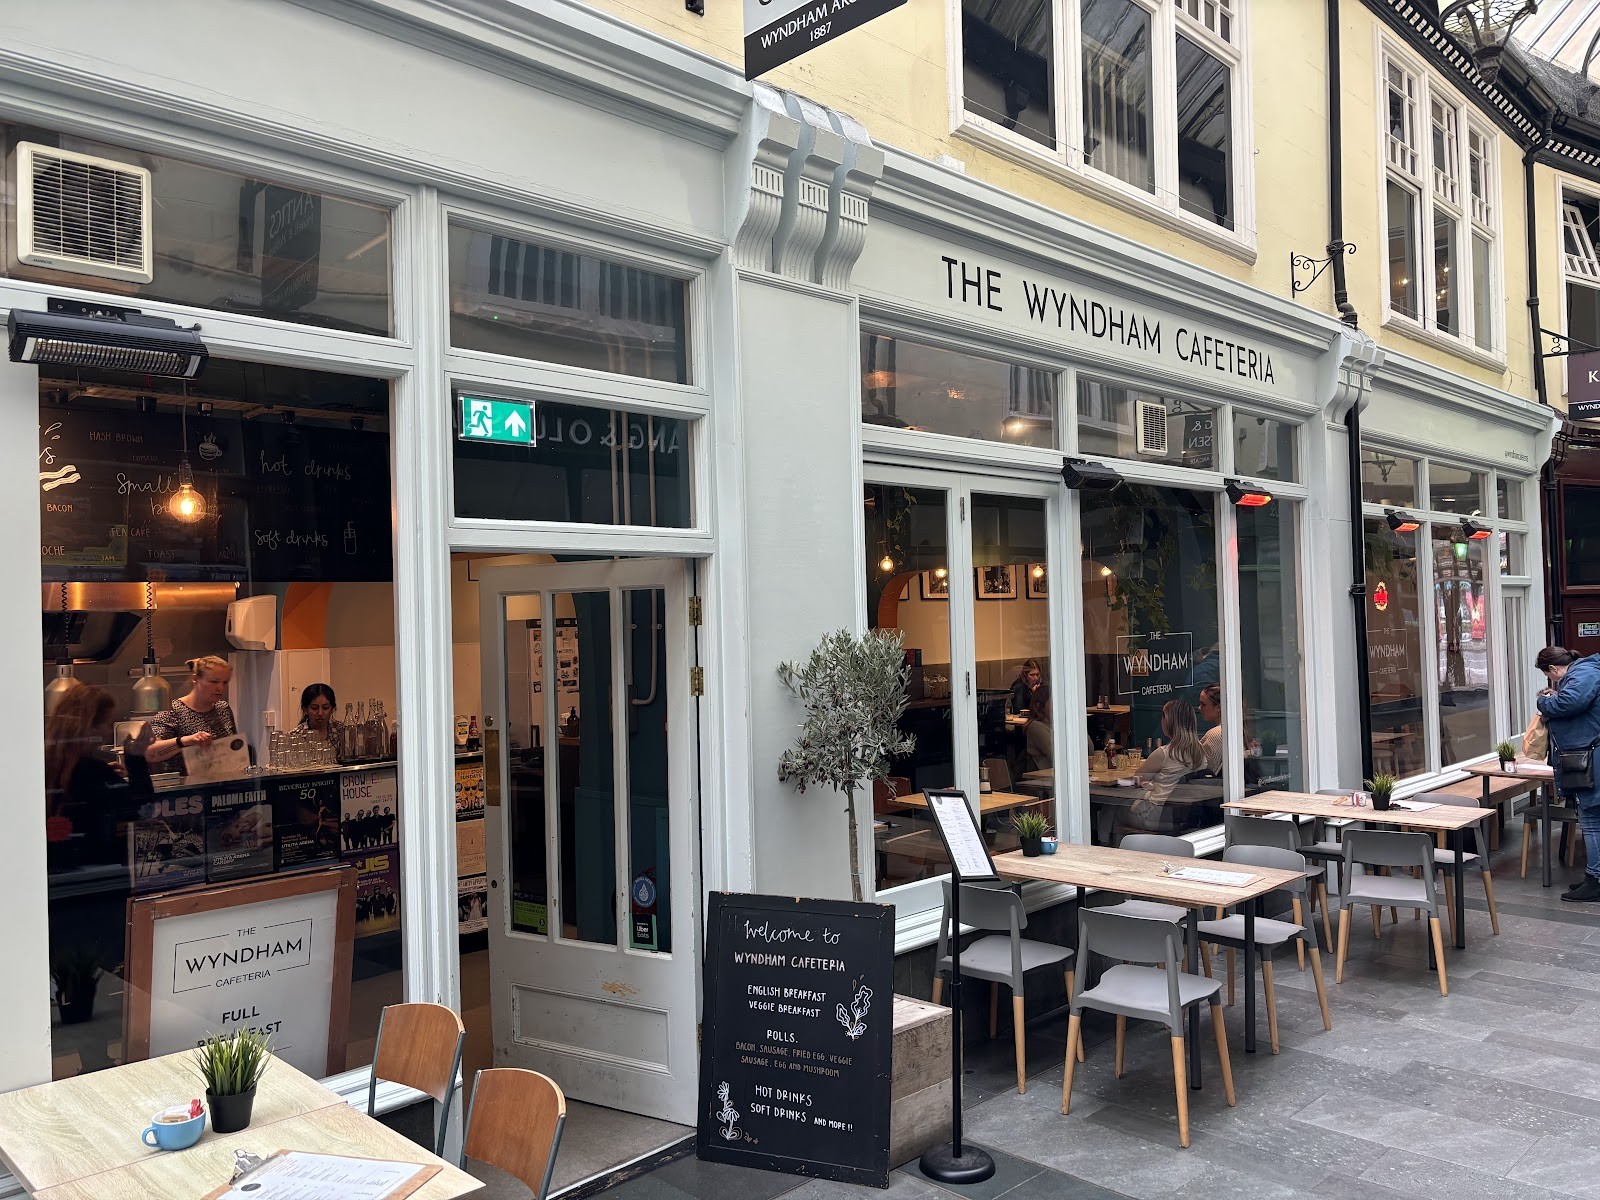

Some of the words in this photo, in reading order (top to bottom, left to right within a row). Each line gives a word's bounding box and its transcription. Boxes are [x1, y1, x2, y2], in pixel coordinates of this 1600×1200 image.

[760, 3, 827, 48] WYNDHAM
[809, 21, 832, 41] 1887
[941, 255, 1003, 312] THE
[1022, 280, 1161, 355] WYNDHAM
[1176, 327, 1275, 385] CAFETERIA
[260, 450, 292, 475] hot
[304, 460, 350, 480] drinks
[47, 503, 73, 513] BACON
[286, 530, 329, 546] drinks
[1150, 631, 1162, 640] THE
[1369, 643, 1405, 659] WYNDHAM
[1123, 651, 1188, 675] WYNDHAM
[1141, 684, 1172, 696] CAFETERIA
[279, 781, 310, 791] BEVERLEY
[300, 788, 317, 800] 50
[343, 786, 373, 800] HOUSE
[212, 792, 243, 808] PALOMA
[244, 789, 267, 803] FAITH
[237, 927, 257, 938] THE
[637, 931, 649, 939] Eats
[823, 928, 841, 945] to
[185, 937, 303, 974] WYNDHAM
[734, 951, 786, 967] WYNDHAM
[791, 956, 846, 972] CAFETERIA
[215, 970, 271, 988] CAFETERIA
[747, 984, 781, 998] ENGLISH
[784, 987, 827, 1003] BREAKFAST
[222, 1006, 261, 1024] FULL
[749, 1000, 776, 1011] VEGGIE
[778, 1003, 822, 1018] BREAKFAST
[792, 1049, 811, 1060] FRIED
[829, 1054, 853, 1066] VEGGIE
[774, 1060, 787, 1070] EGG
[789, 1062, 801, 1071] AND
[803, 1064, 840, 1078] MUSHROOM
[755, 1085, 773, 1098] HOT
[776, 1089, 813, 1107] DRINKS
[750, 1103, 771, 1116] SOFT
[774, 1108, 807, 1123] DRINKS
[814, 1117, 827, 1127] AND
[829, 1120, 846, 1131] MORE
